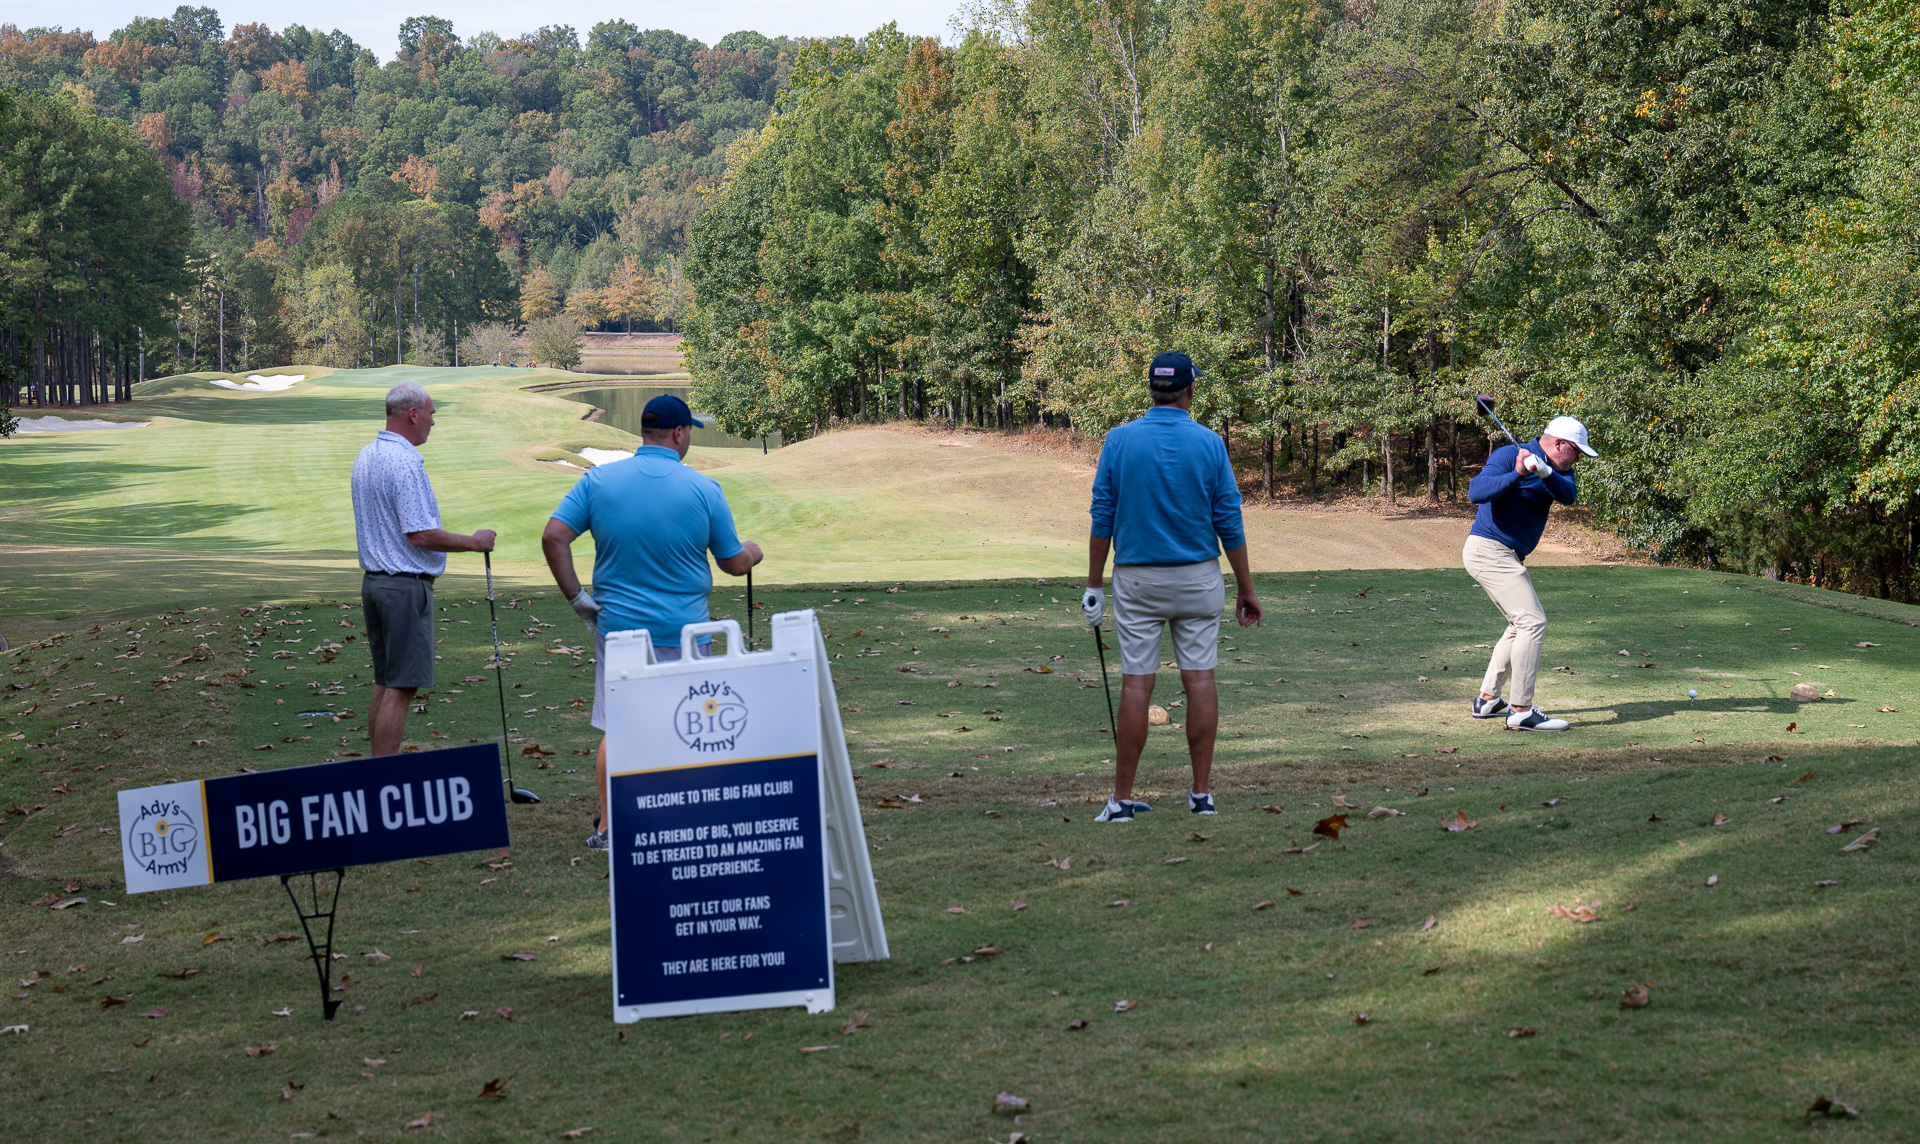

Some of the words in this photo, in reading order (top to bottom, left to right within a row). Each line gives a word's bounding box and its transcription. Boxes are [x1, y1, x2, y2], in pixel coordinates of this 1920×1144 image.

[689, 680, 731, 700] Ady's
[689, 735, 735, 752] Army
[637, 791, 686, 809] WELCOME
[686, 789, 700, 804] TO
[701, 788, 721, 802] THE
[723, 785, 741, 800] BIG
[742, 783, 762, 798] FAN
[763, 780, 793, 796] CLUB!
[141, 800, 180, 820] Ady's
[235, 799, 292, 849] BIG
[301, 789, 369, 840] FAN
[379, 776, 474, 830] CLUB
[634, 832, 648, 847] AS
[649, 831, 657, 846] A
[658, 827, 694, 845] FRIEND
[696, 826, 710, 840] OF
[711, 824, 732, 839] BIG,
[732, 822, 752, 836] YOU
[754, 817, 799, 835] DESERVE
[631, 851, 645, 866] TO
[646, 850, 660, 864] BE
[661, 845, 704, 862] TREATED
[705, 844, 719, 858] TO
[720, 842, 735, 857] AN
[736, 838, 782, 855] AMAZING
[784, 835, 804, 850] FAN
[145, 857, 187, 875] Army
[671, 865, 698, 880] CLUB
[699, 858, 764, 878] EXPERIENCE.
[669, 902, 700, 918] DON'T
[702, 900, 720, 915] LET
[721, 898, 743, 913] OUR
[744, 896, 771, 911] FANS
[675, 921, 695, 936] GET
[697, 920, 709, 934] IN
[709, 918, 737, 933] YOUR
[738, 915, 763, 931] WAY.
[662, 960, 688, 975] THEY
[689, 959, 709, 973] ARE
[711, 956, 738, 971] HERE
[740, 953, 760, 968] FOR
[760, 951, 785, 967] YOU!
